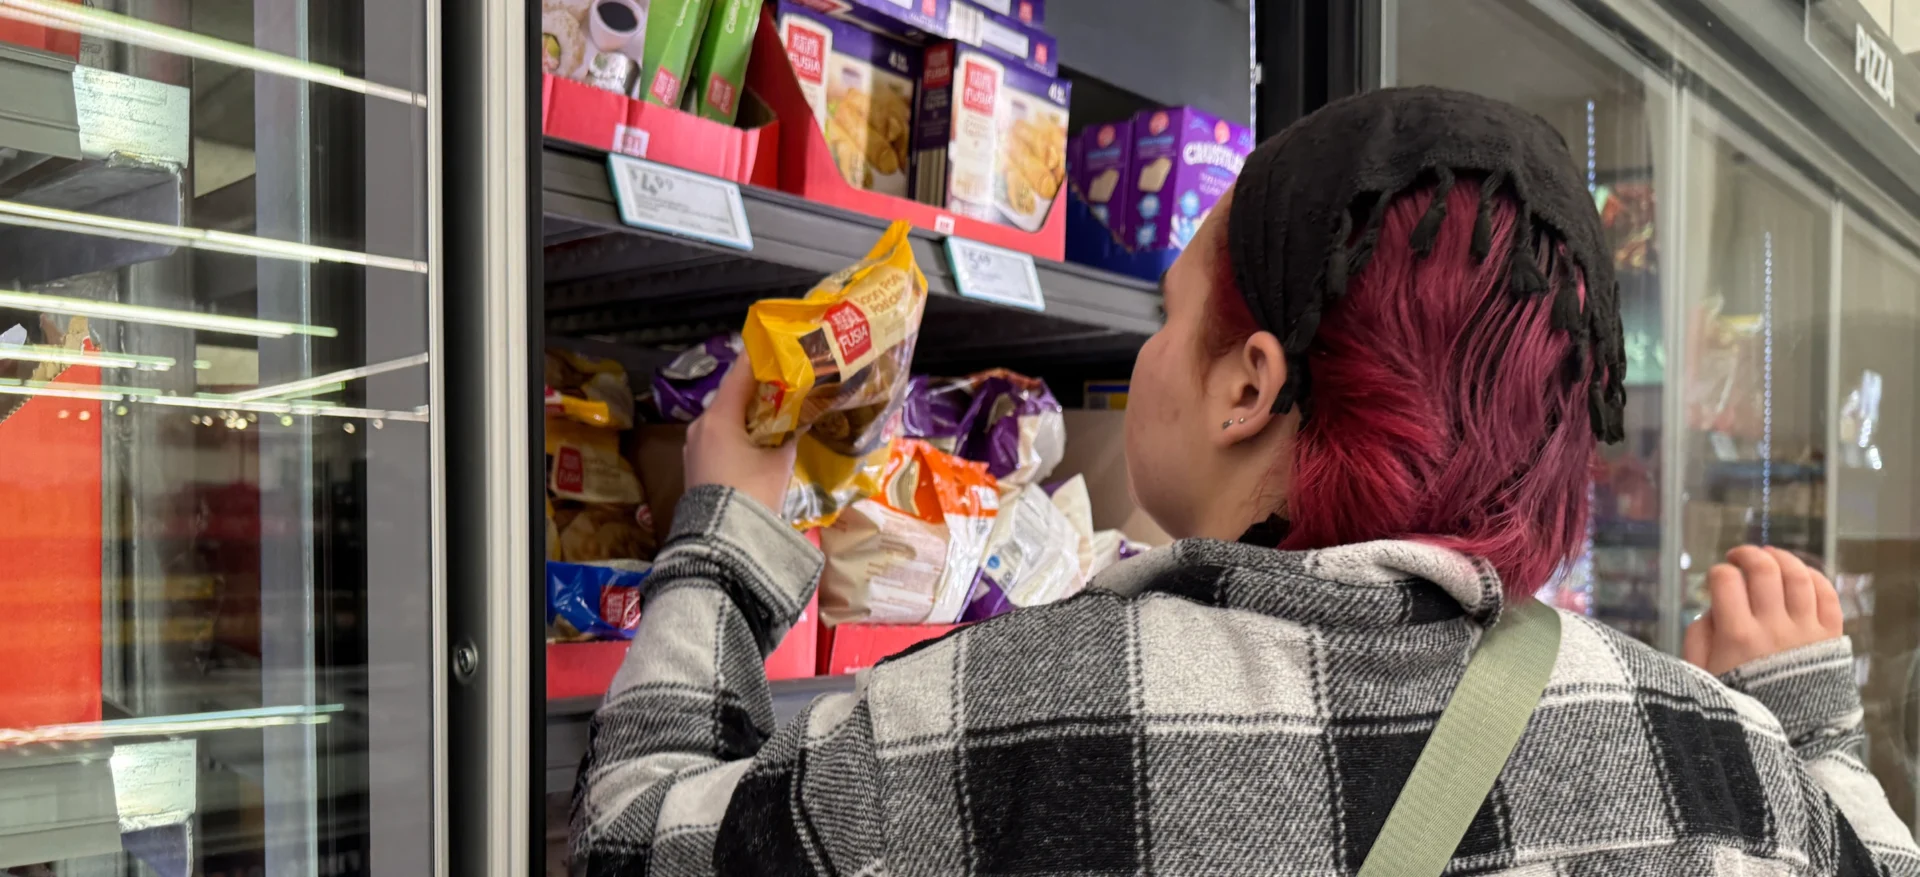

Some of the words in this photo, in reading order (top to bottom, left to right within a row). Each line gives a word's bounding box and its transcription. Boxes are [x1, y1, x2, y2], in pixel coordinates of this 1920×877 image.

[1855, 22, 1896, 109] PIZZA
[965, 87, 995, 105] FUSIA
[839, 324, 869, 357] FUSIA
